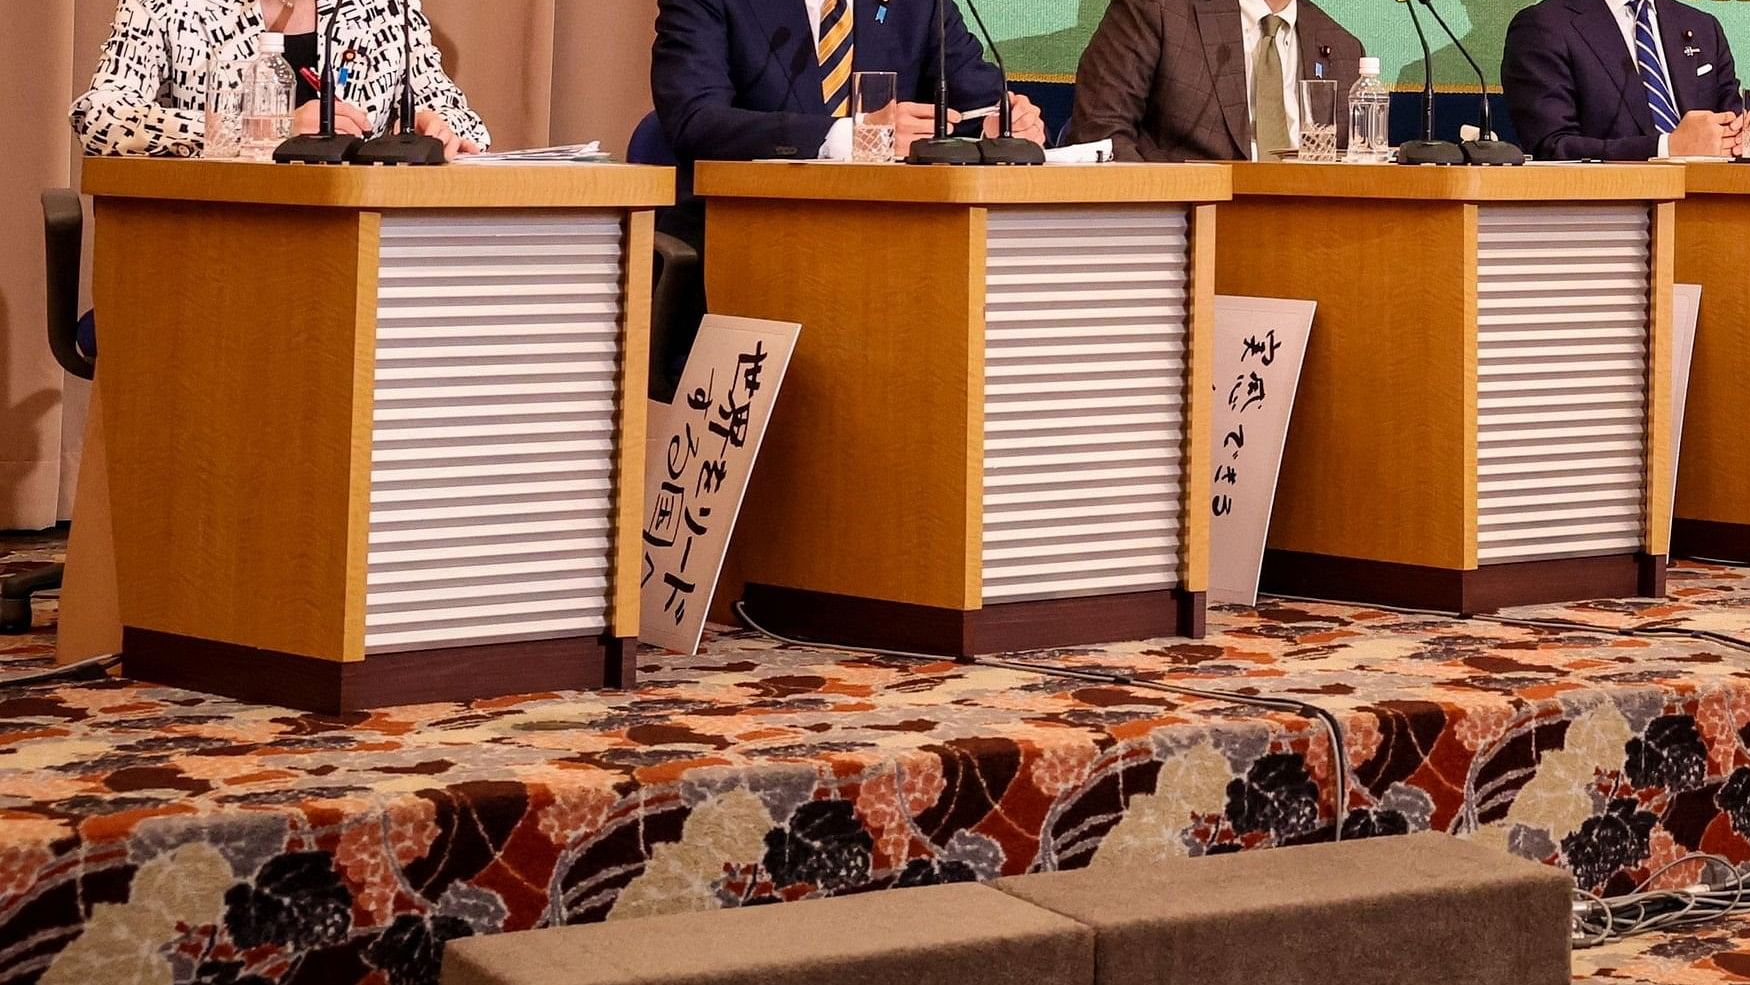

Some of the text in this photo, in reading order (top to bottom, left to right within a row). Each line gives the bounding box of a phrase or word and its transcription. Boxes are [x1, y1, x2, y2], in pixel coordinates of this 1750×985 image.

[663, 340, 768, 627] 世界をリード
[1211, 329, 1282, 517] 実感できる
